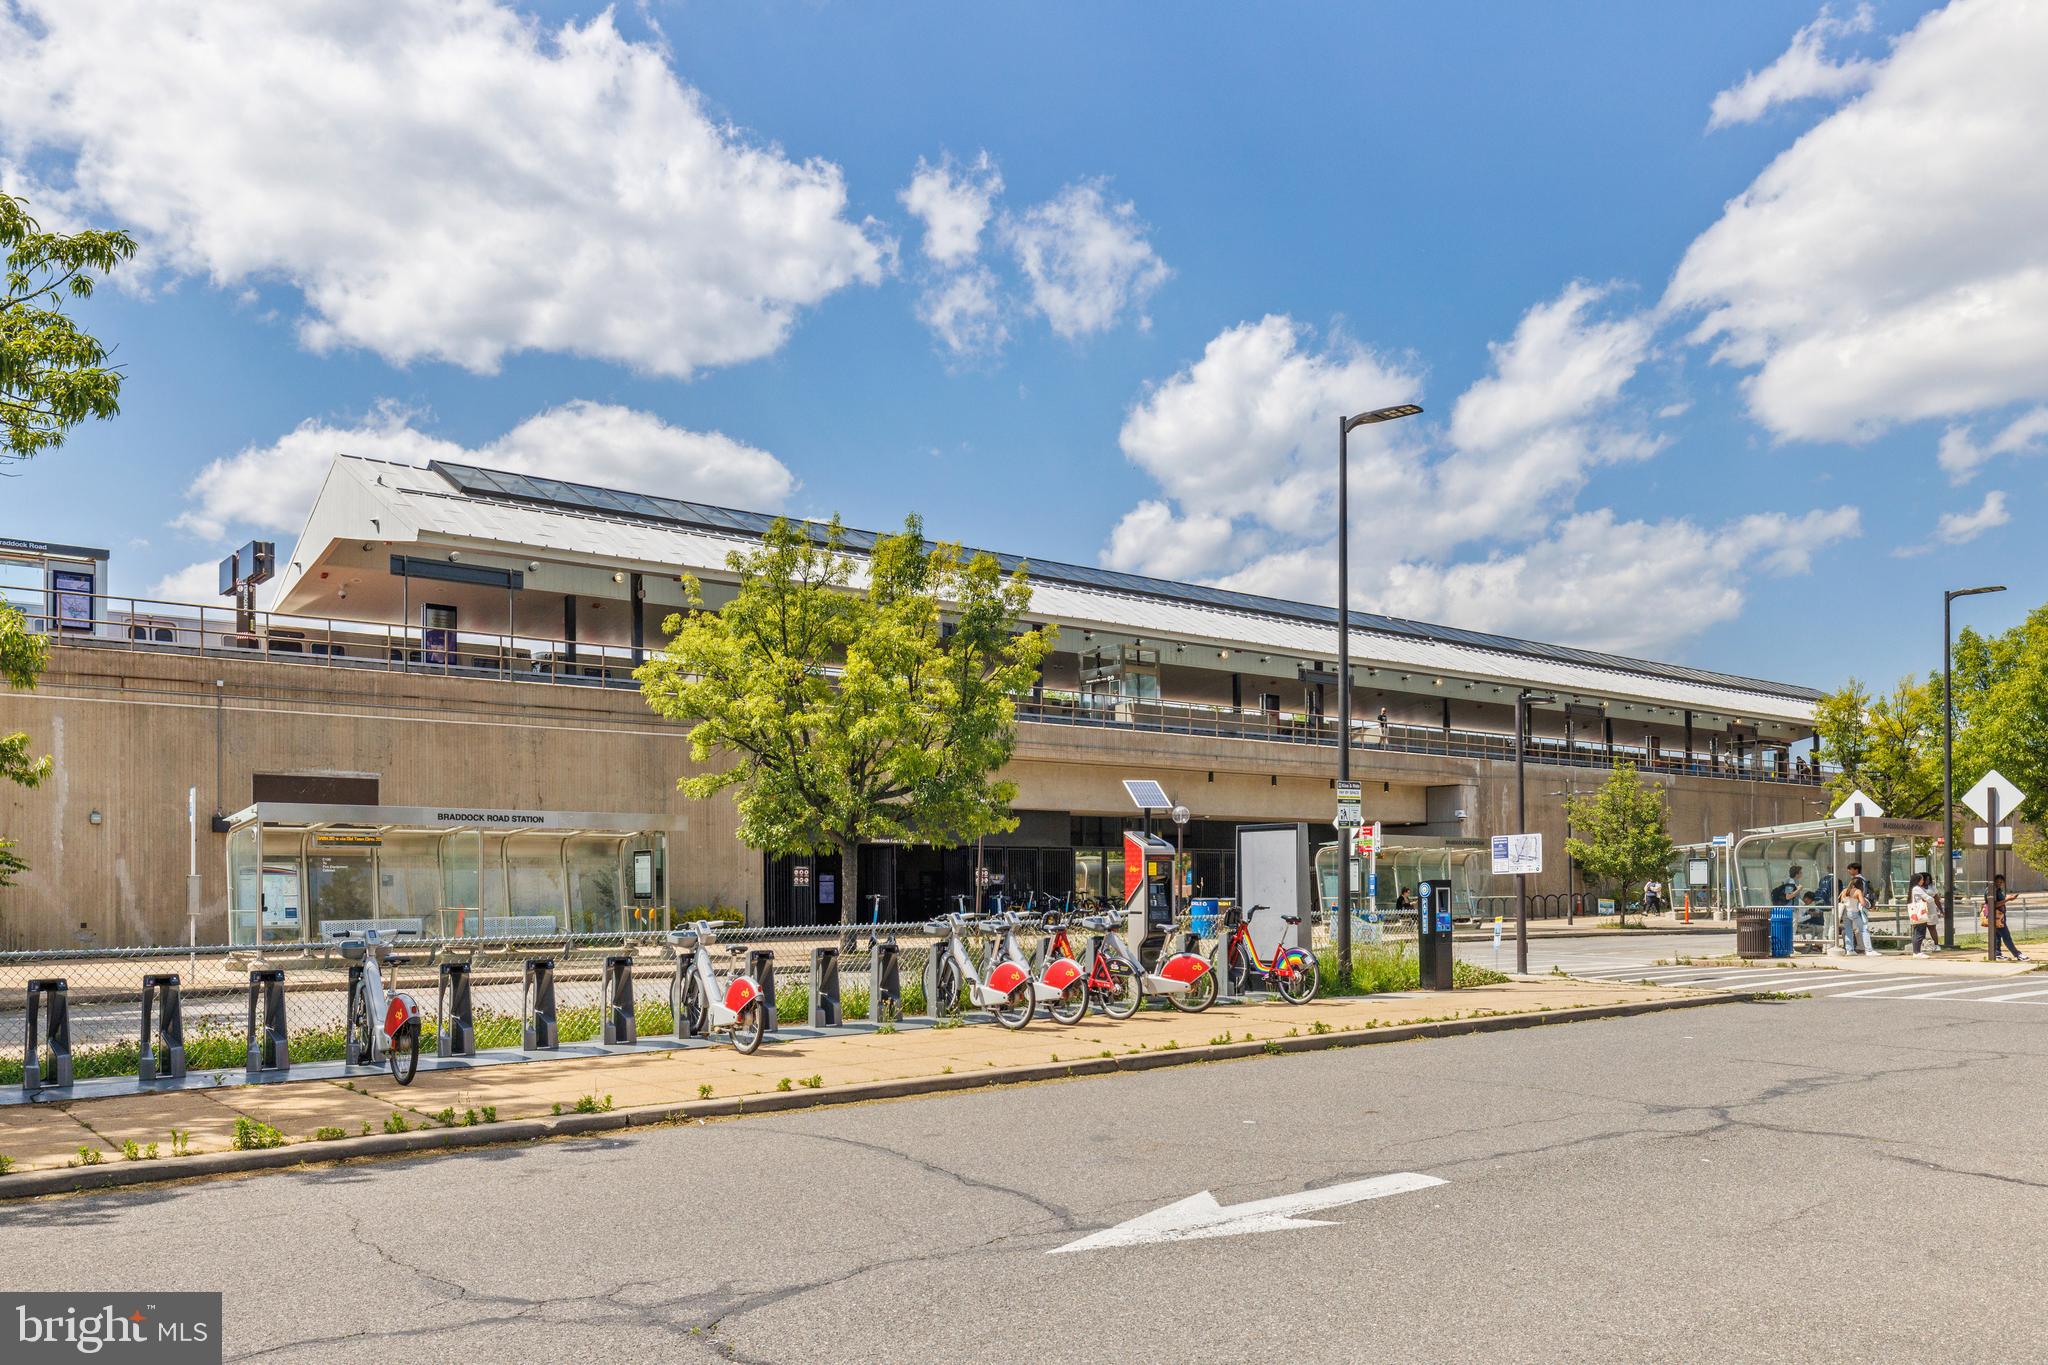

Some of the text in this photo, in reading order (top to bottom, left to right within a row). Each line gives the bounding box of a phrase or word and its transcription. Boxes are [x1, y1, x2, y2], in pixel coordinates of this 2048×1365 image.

[0, 540, 48, 550] raddock Road
[437, 813, 544, 823] BRADDOCK ROAD STATION
